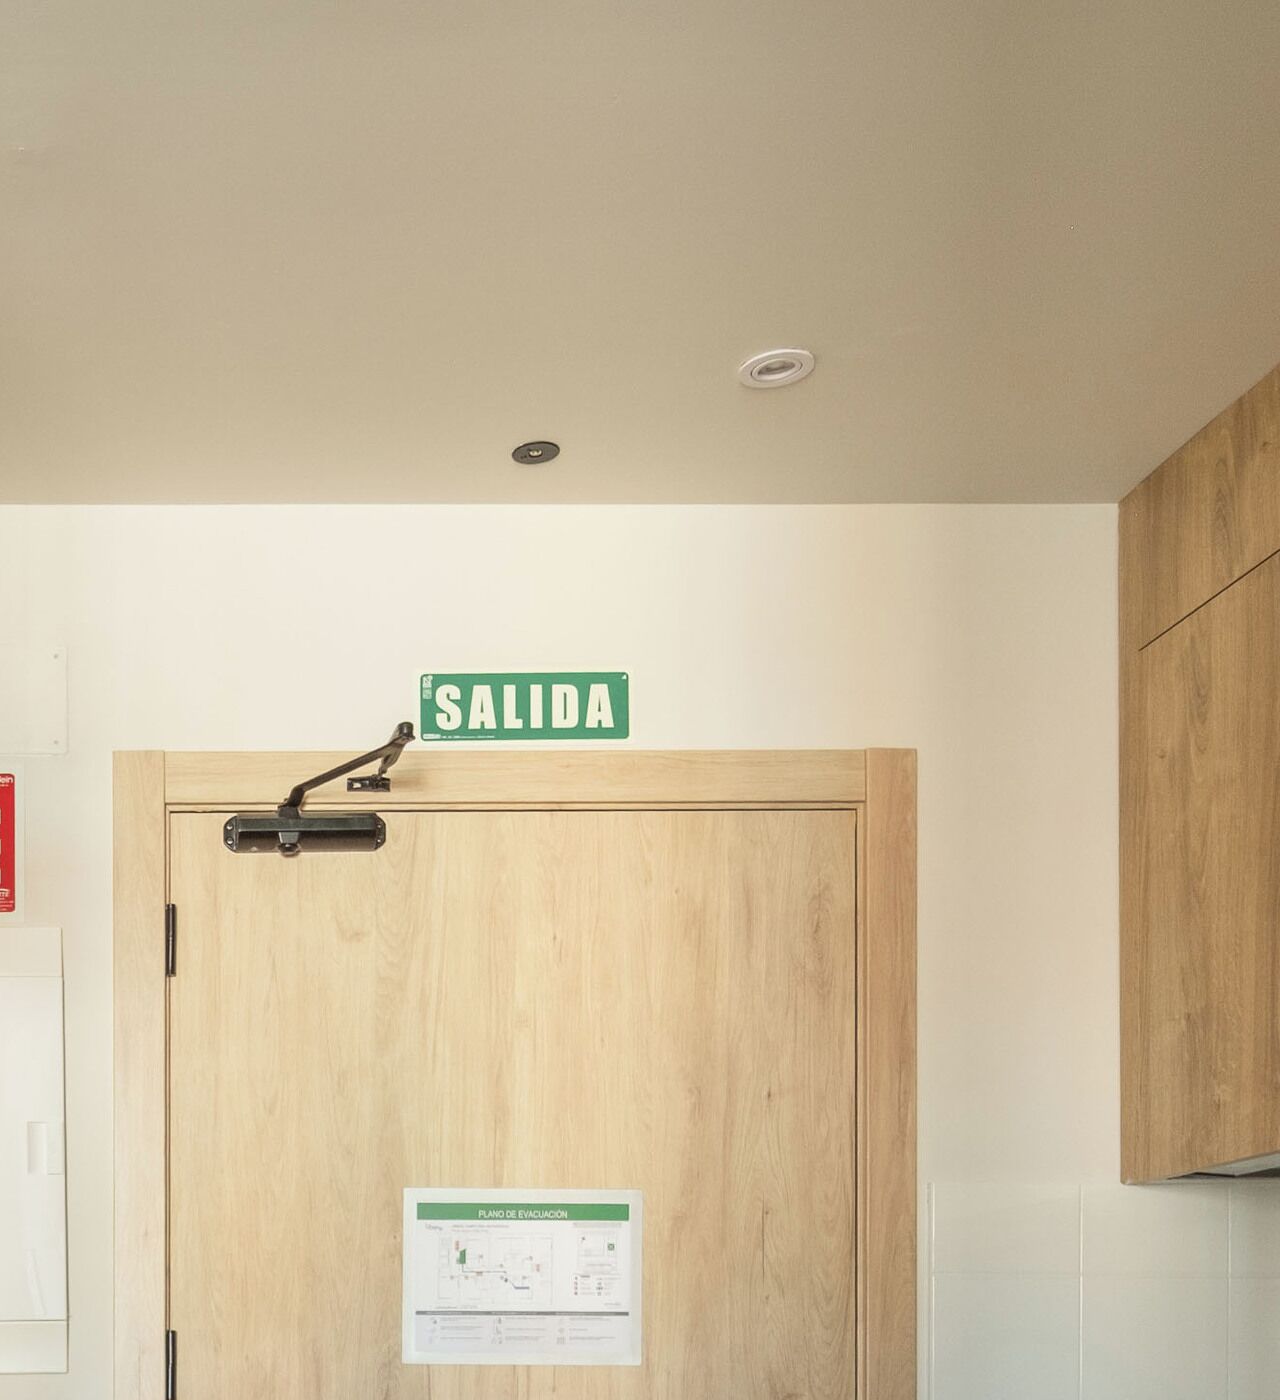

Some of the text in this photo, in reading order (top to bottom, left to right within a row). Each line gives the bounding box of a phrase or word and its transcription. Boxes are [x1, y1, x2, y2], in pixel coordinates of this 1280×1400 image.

[435, 683, 615, 731] SALIDA
[478, 1208, 568, 1219] PLANO DE EVACUACIÓN
